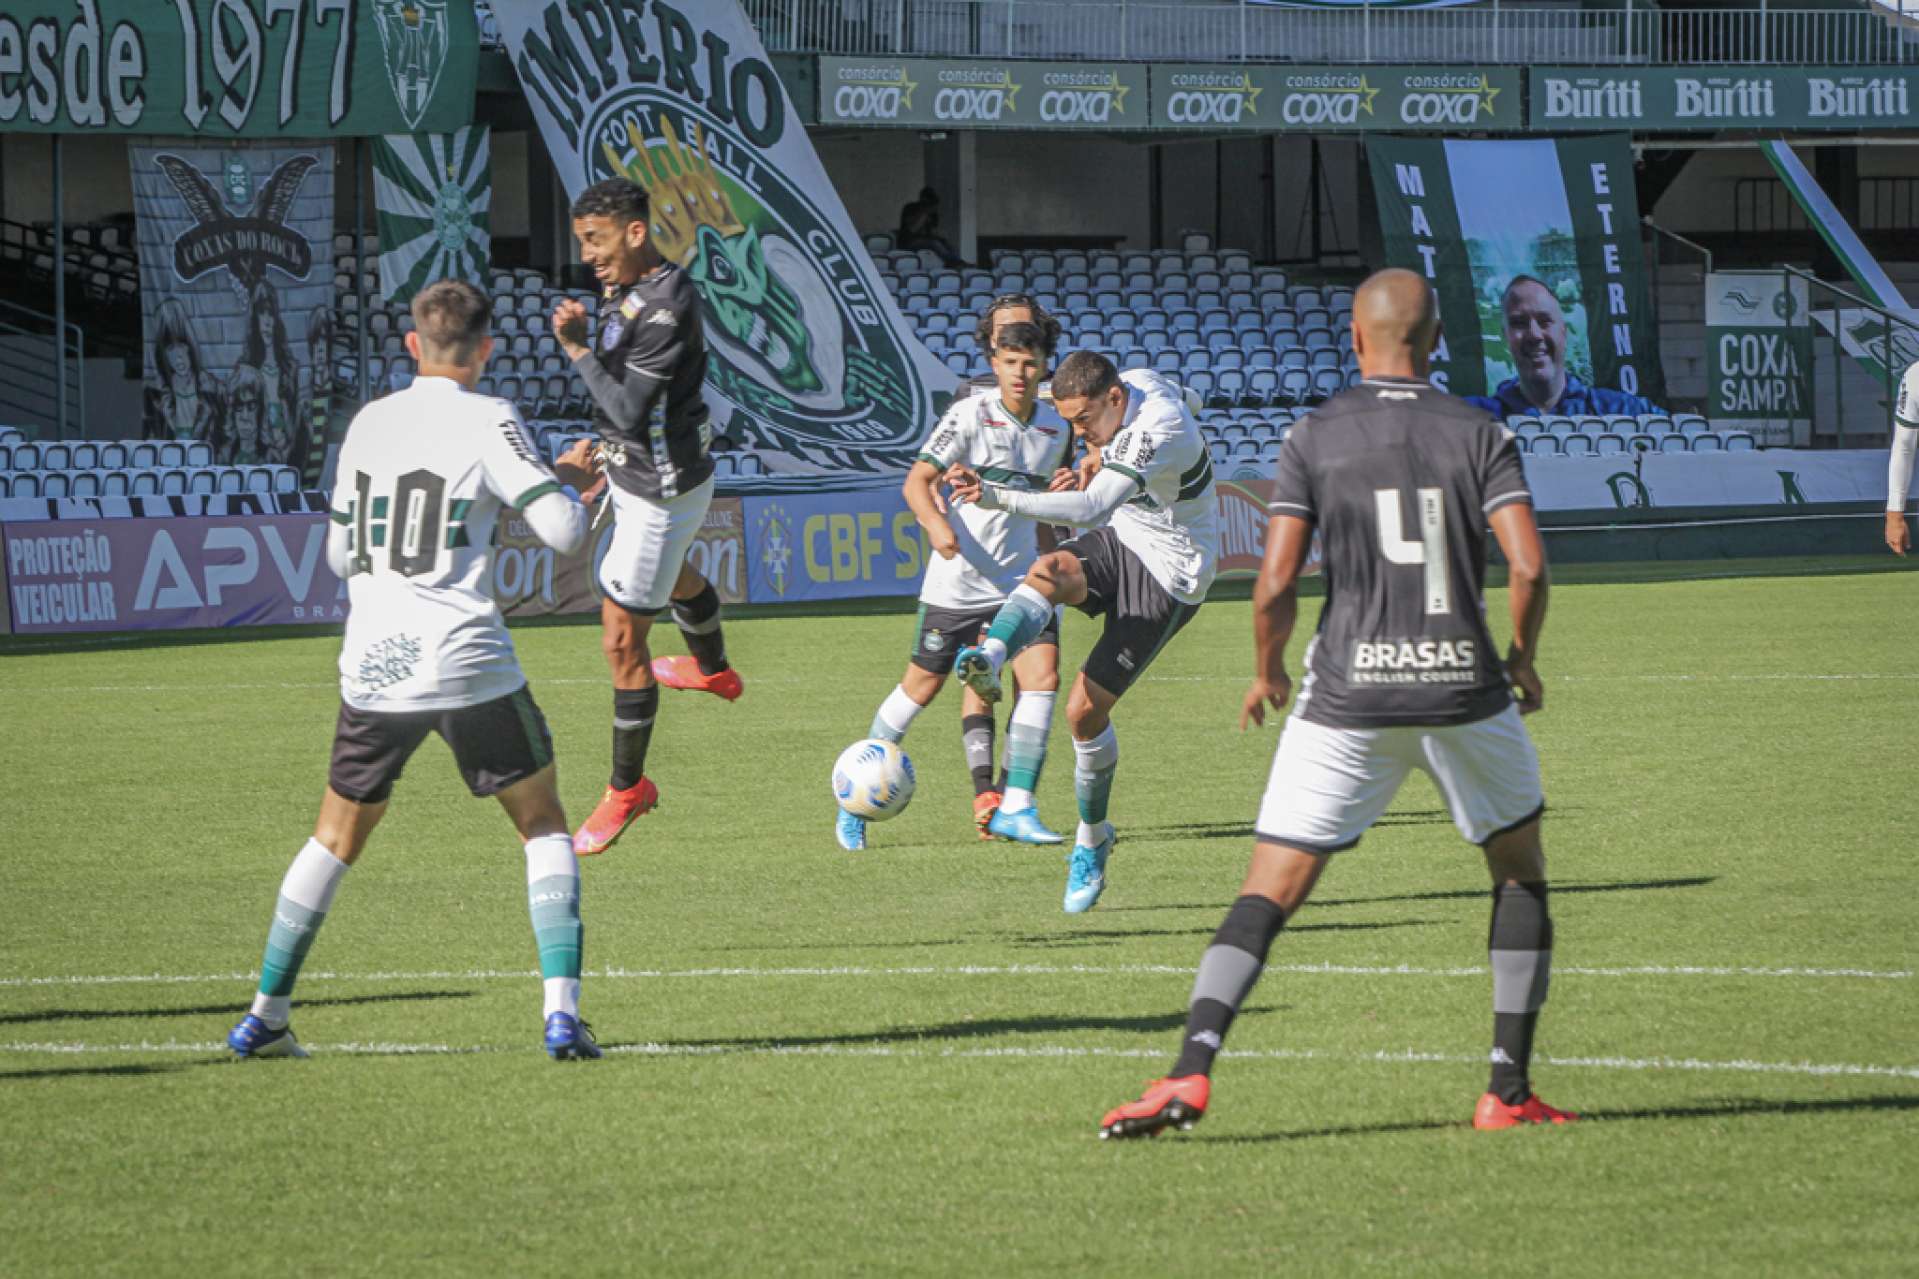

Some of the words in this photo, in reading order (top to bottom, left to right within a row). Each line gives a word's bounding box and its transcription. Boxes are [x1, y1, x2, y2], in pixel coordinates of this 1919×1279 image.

[168, 0, 353, 131] 1977
[838, 66, 902, 80] consórcio
[938, 68, 1004, 82] consórcio
[1044, 71, 1111, 85] consórcio
[1171, 71, 1244, 86] consórcio
[1287, 72, 1360, 87] consórcio
[1405, 72, 1480, 87] consórcio
[835, 86, 900, 118] coxa
[934, 88, 1003, 120] coxa
[1040, 91, 1111, 122] coxa
[1167, 92, 1243, 122] coxa
[1283, 93, 1359, 124] coxa
[1400, 93, 1479, 124] coxa
[1544, 78, 1643, 118] Buriti
[1675, 78, 1775, 118] Buriti
[1808, 78, 1910, 118] Buriti
[807, 228, 879, 328] CLUB
[1590, 162, 1639, 396] ETERNO
[1719, 333, 1799, 377] COXA
[1721, 378, 1800, 411] SAMPA
[349, 468, 447, 577] 10
[9, 529, 112, 579] PROTEÇÃO
[803, 512, 883, 582] CBF
[1373, 487, 1451, 615] 4
[134, 524, 346, 611] APV
[13, 582, 117, 624] VEICULAR
[293, 606, 345, 618] BRA
[1354, 640, 1476, 669] BRASAS
